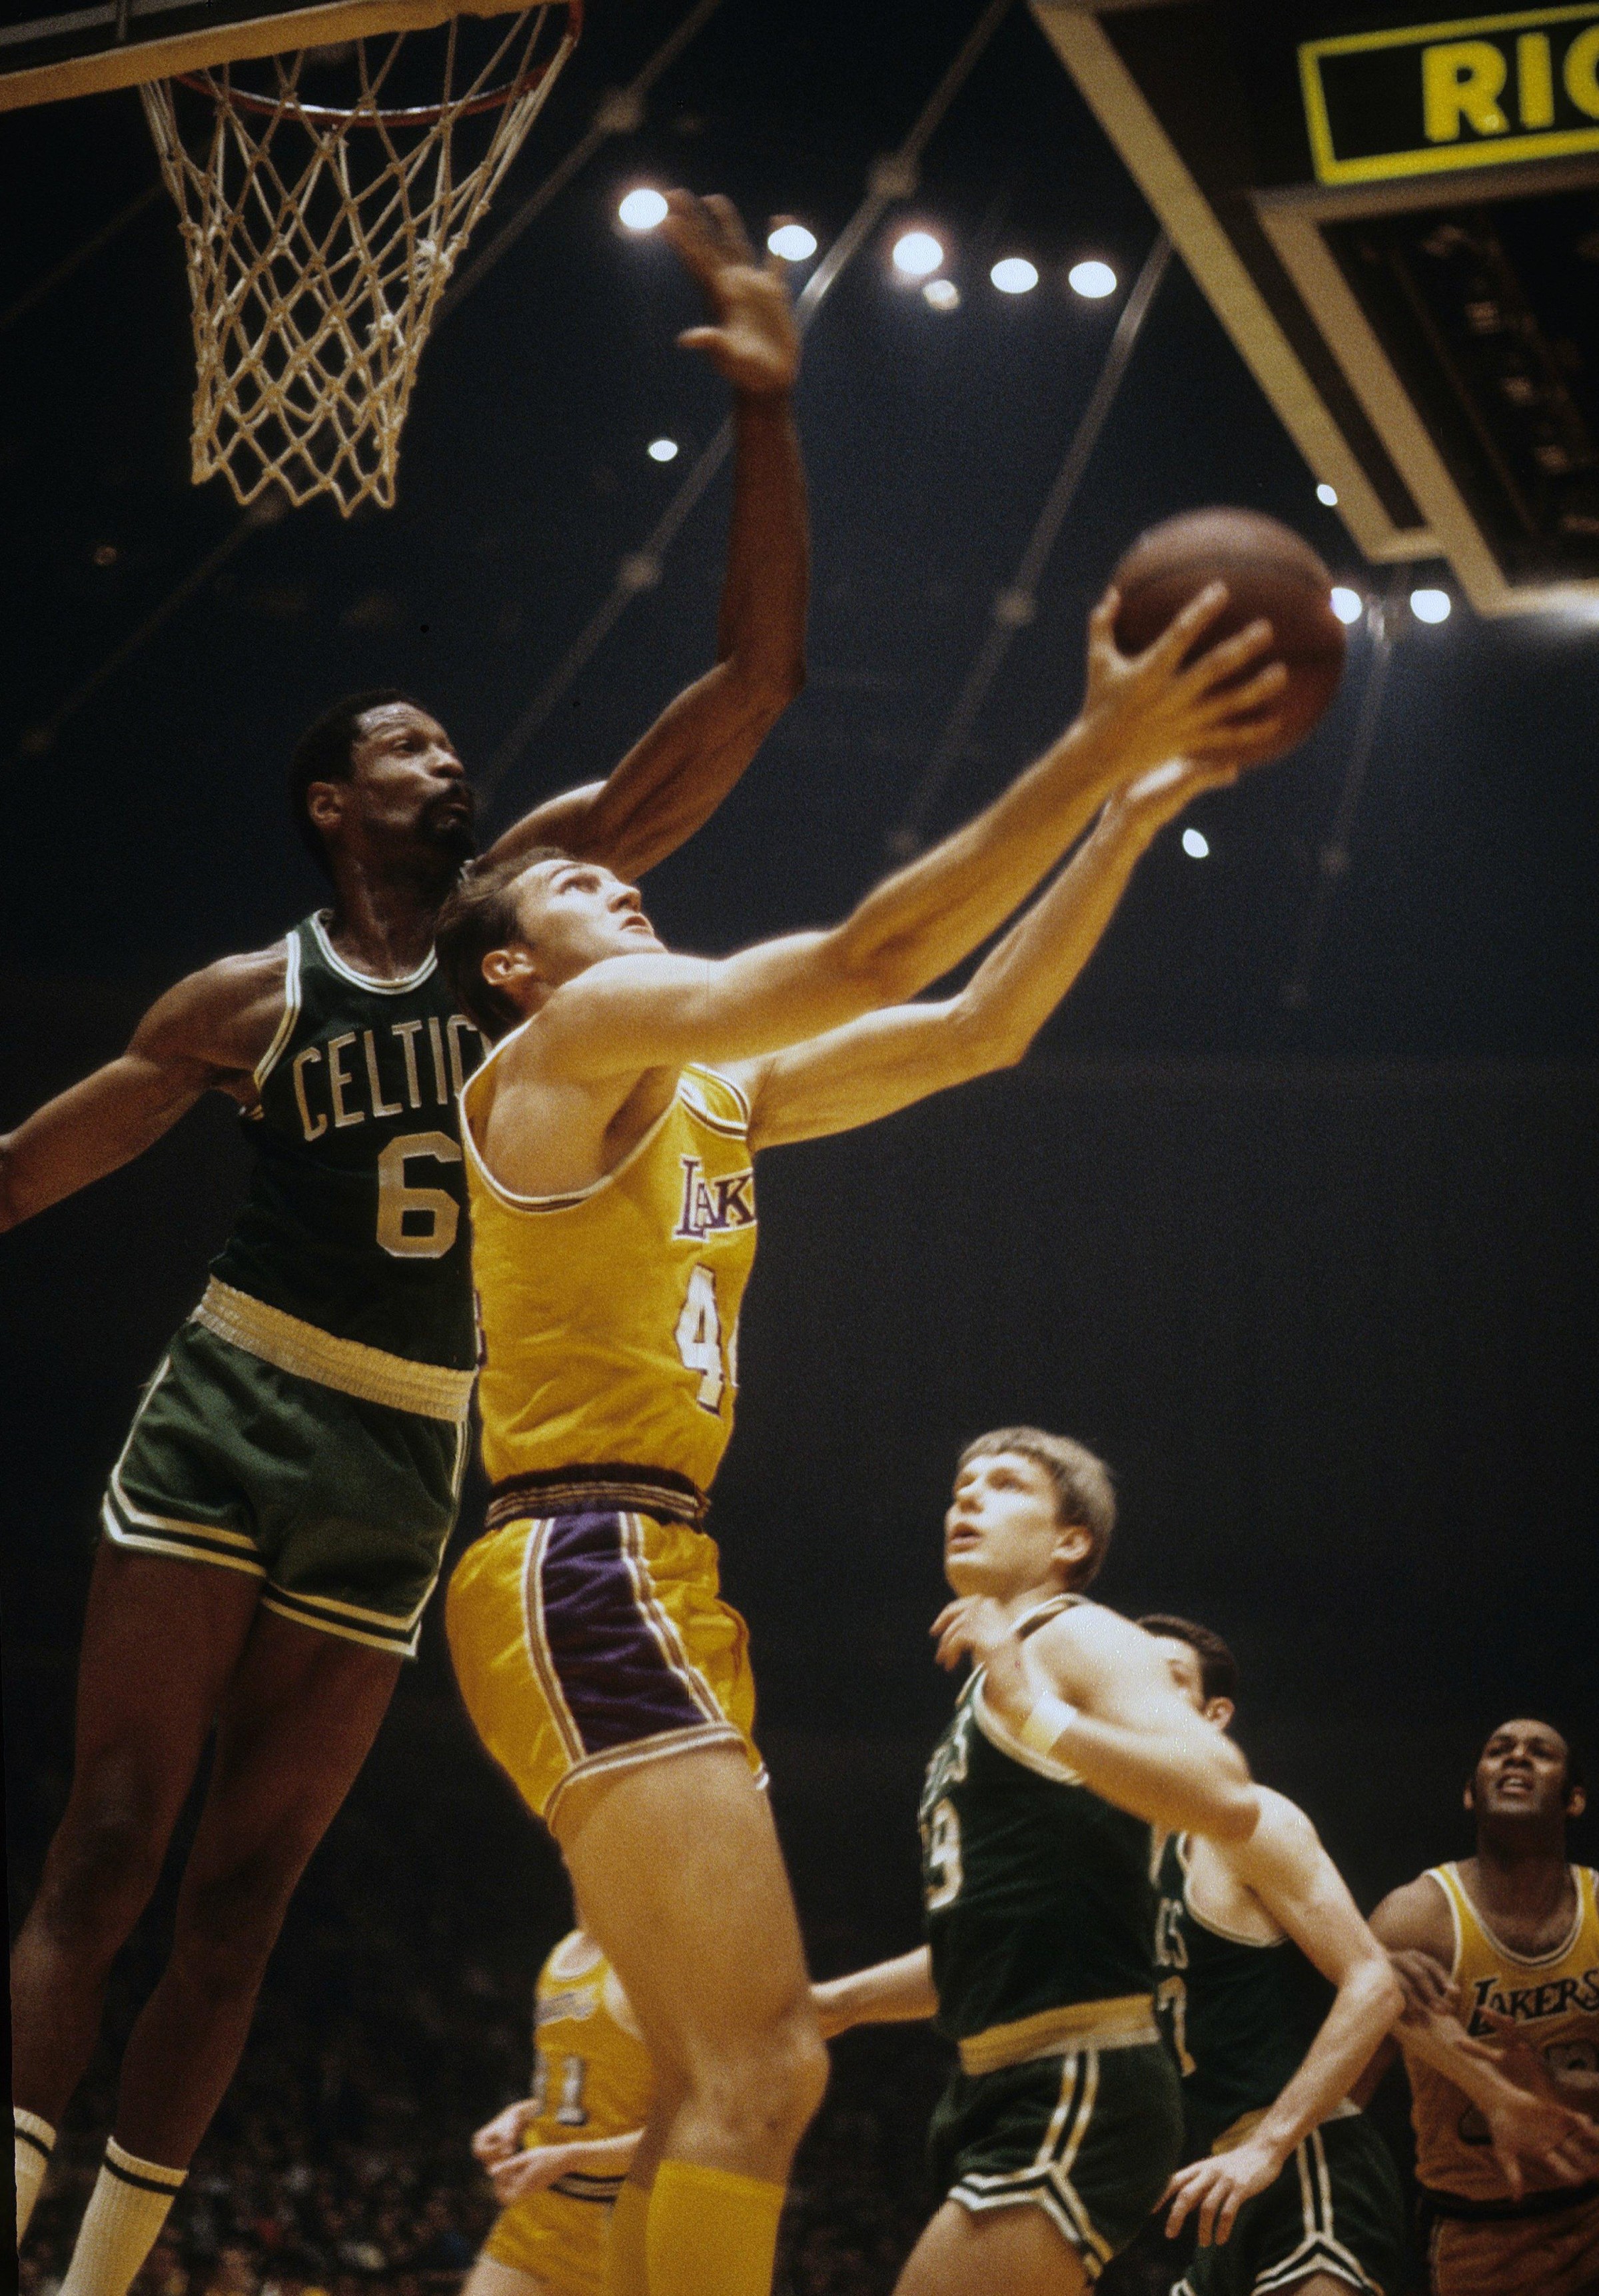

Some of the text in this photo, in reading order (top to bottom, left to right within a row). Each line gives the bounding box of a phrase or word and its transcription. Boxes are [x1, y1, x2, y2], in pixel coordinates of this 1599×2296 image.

[292, 1013, 493, 1142] CELTIC
[376, 1131, 464, 1259] 6
[674, 1262, 739, 1418] 4
